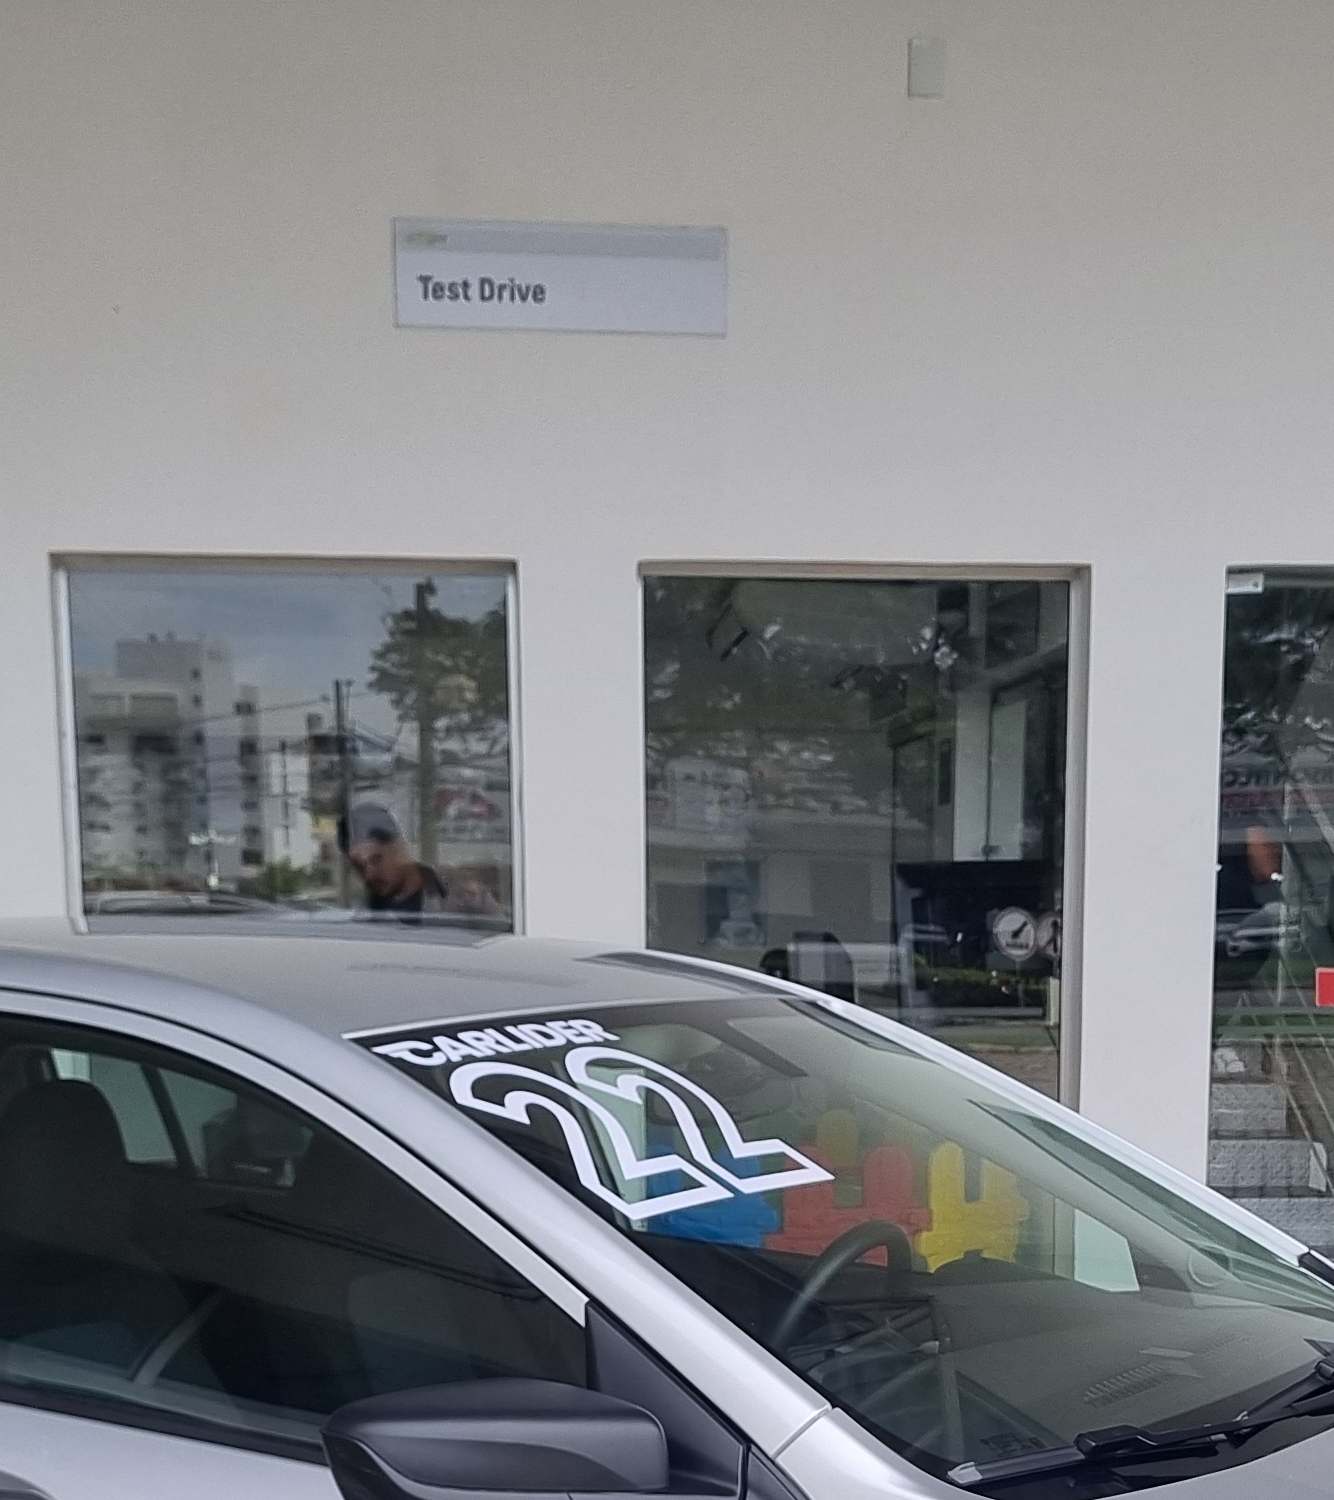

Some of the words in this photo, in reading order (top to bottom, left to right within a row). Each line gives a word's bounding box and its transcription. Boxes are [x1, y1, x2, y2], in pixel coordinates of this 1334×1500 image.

[416, 274, 472, 302] Test
[478, 276, 547, 304] Drive
[371, 1018, 622, 1067] CARLIDER
[449, 1046, 836, 1221] 22
